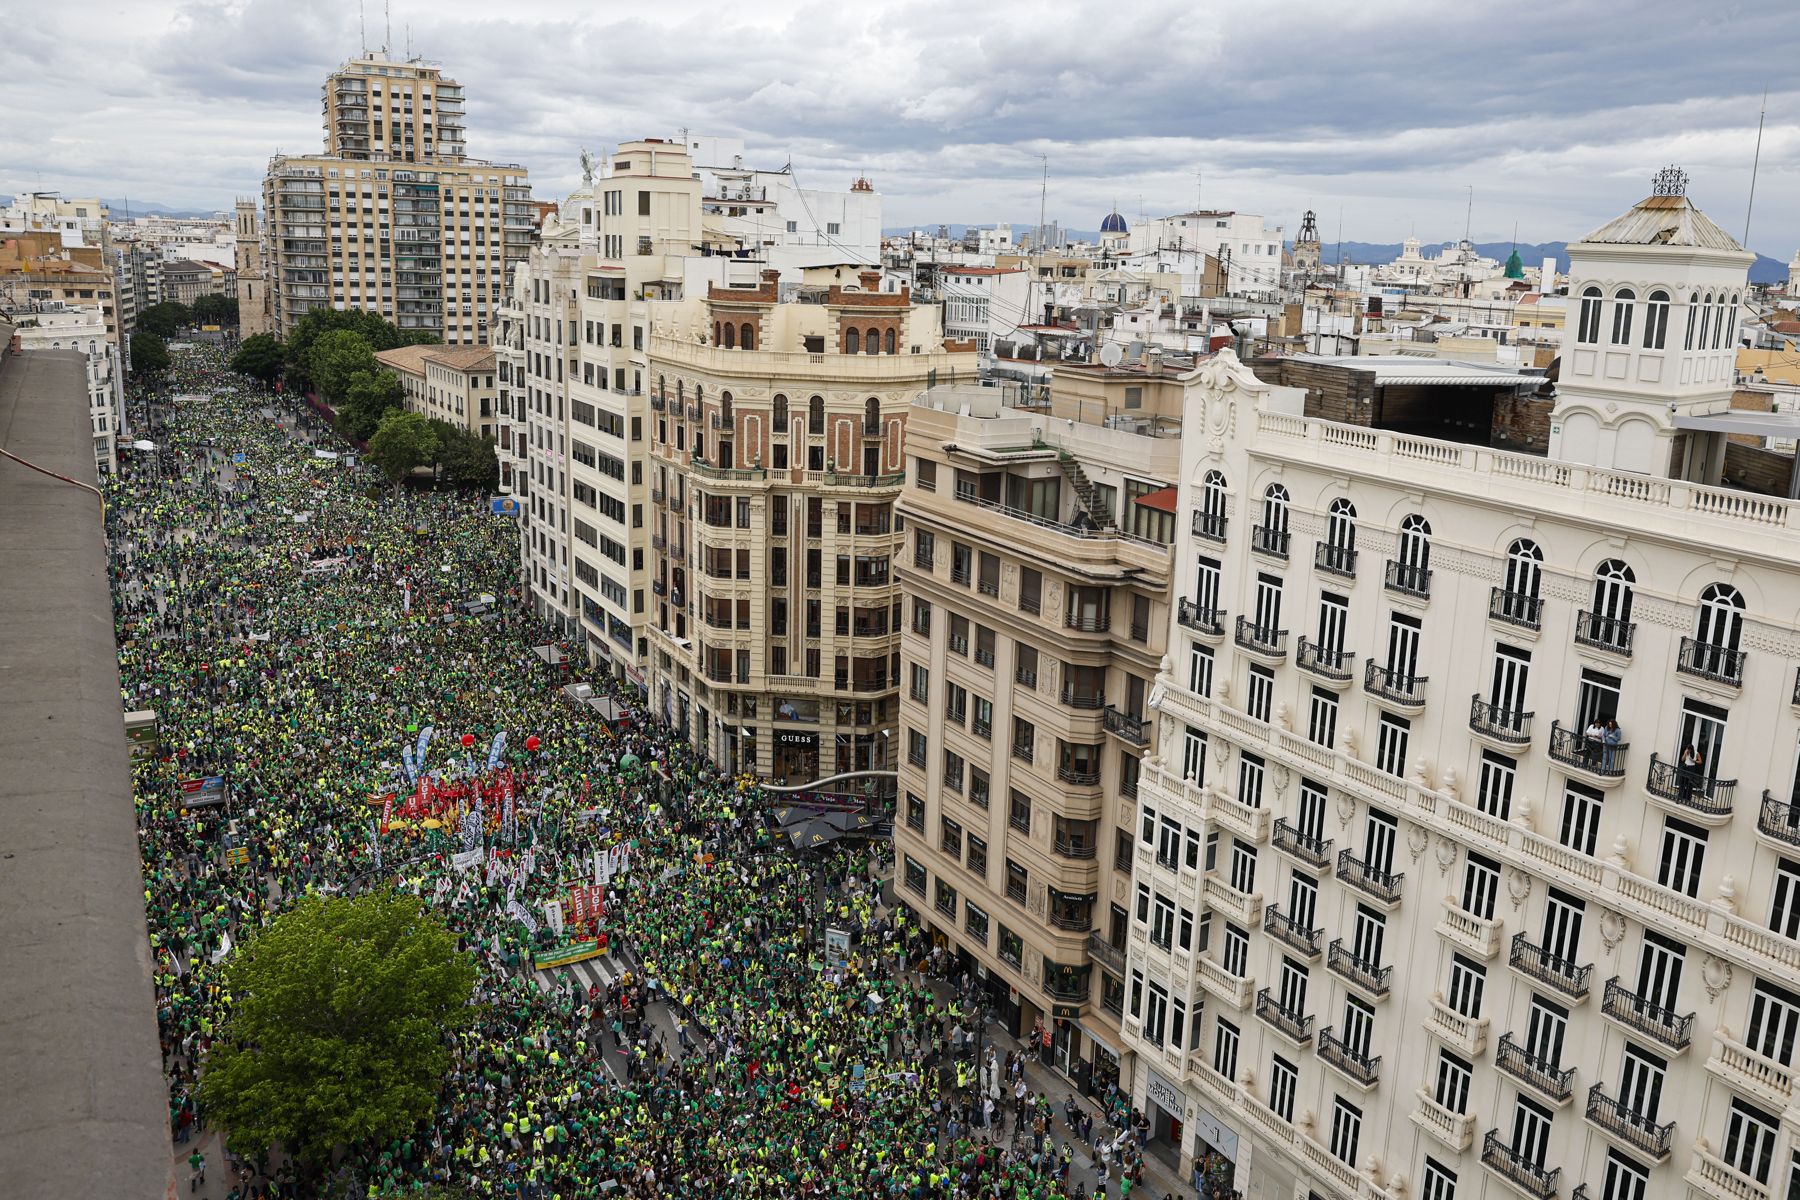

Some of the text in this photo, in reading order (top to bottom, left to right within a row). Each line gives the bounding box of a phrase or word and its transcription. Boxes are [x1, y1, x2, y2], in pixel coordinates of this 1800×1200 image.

[781, 735, 811, 743] GUESS
[592, 887, 600, 912] UGT
[1148, 1083, 1183, 1116] MOMENTS
[1153, 1081, 1176, 1103] SUPER
